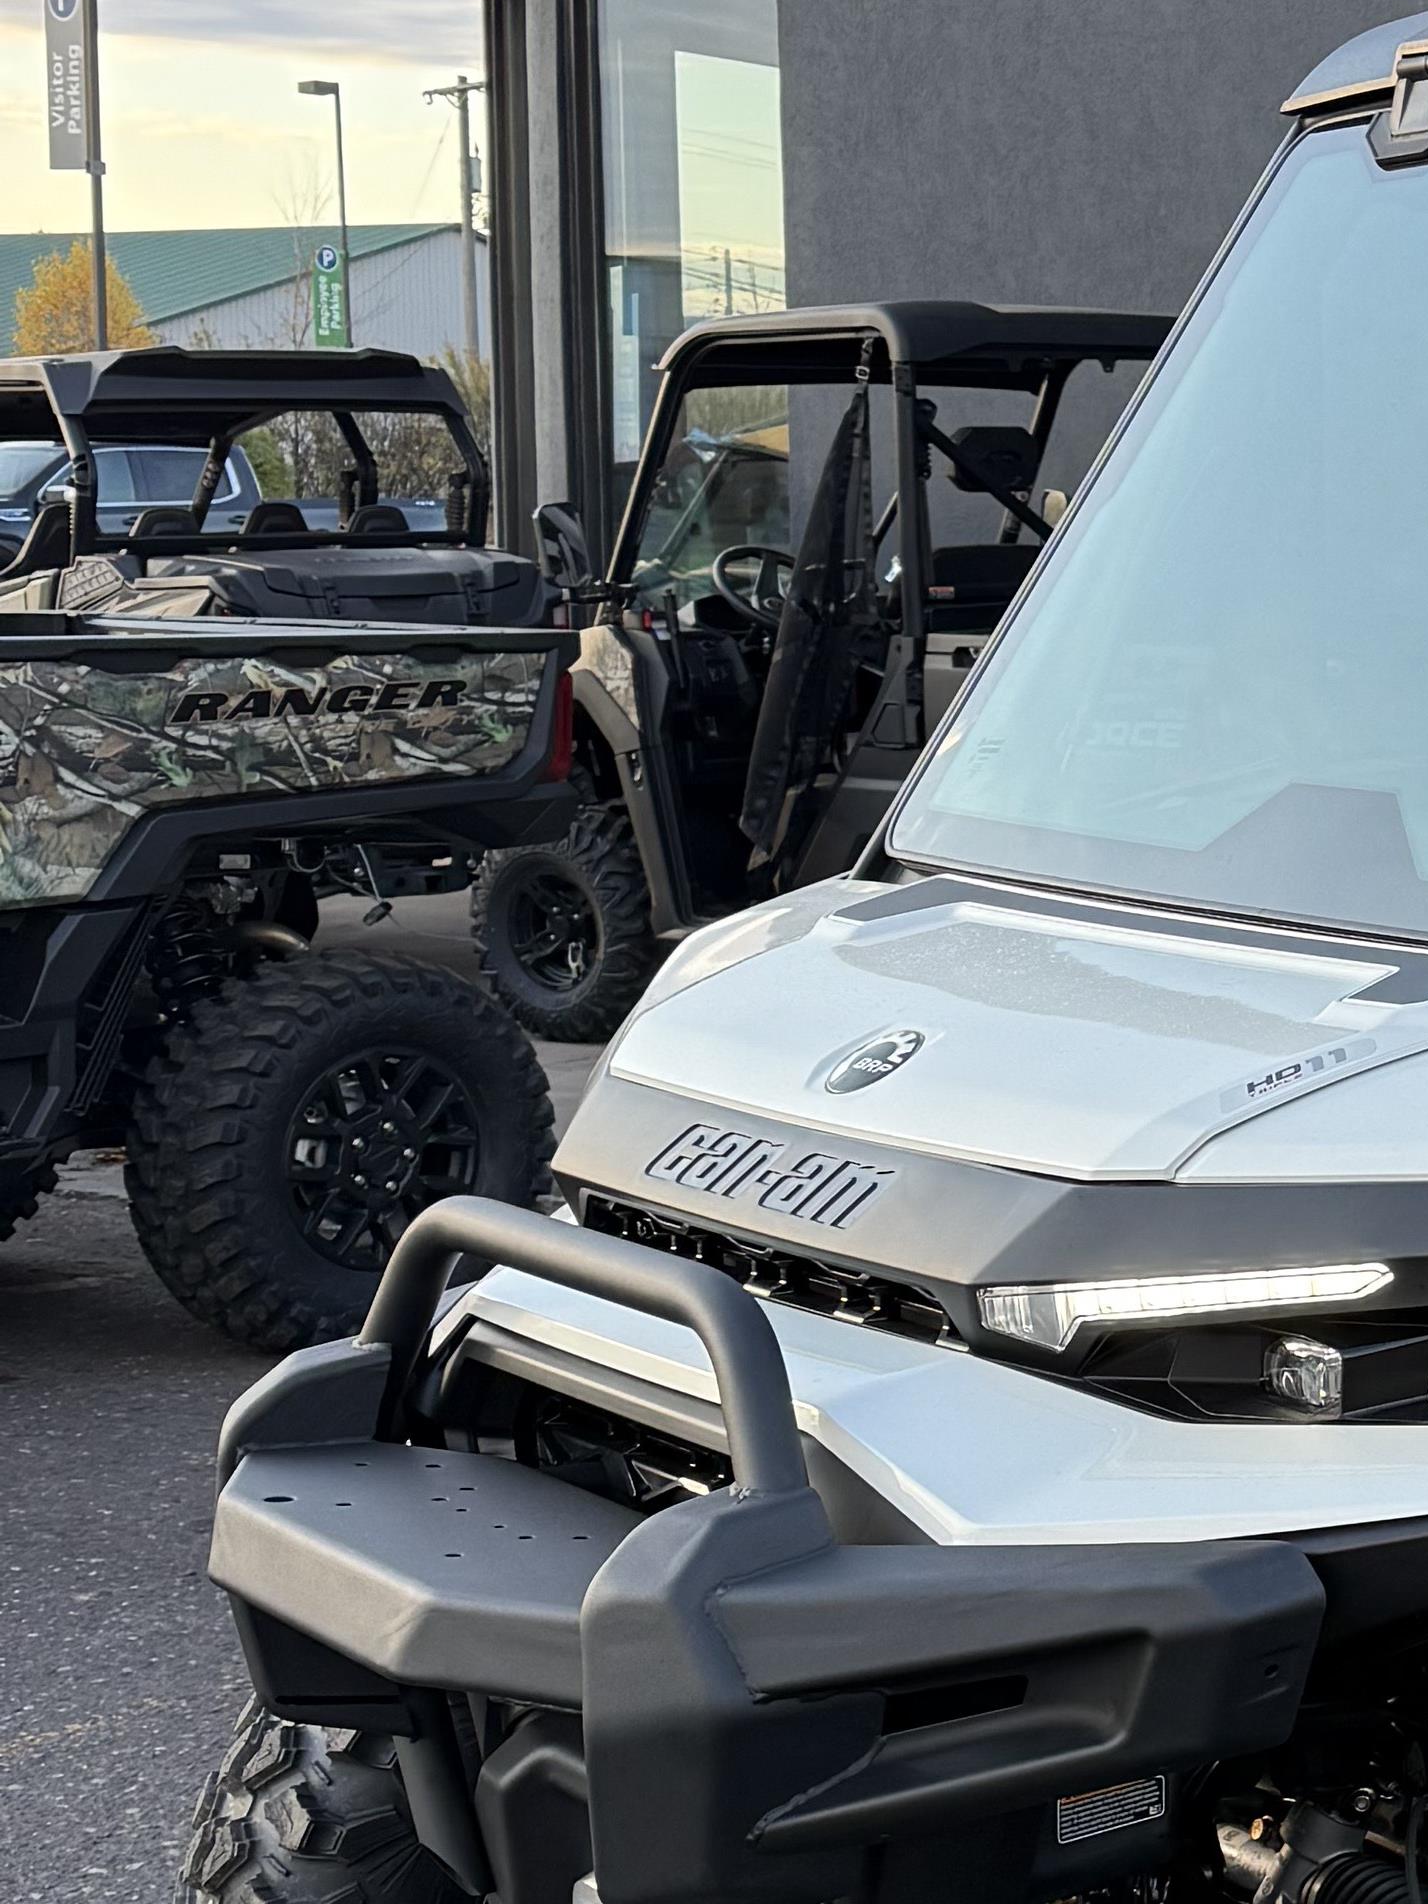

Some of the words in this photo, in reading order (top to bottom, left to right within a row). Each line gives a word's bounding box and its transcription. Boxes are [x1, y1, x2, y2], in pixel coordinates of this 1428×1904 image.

[51, 51, 65, 128] Visitor
[66, 44, 82, 135] Parking
[322, 249, 334, 267] P
[329, 283, 341, 329] Parking
[169, 679, 469, 724] RANGER
[854, 1057, 893, 1075] BRP
[644, 1122, 896, 1230] can-am
